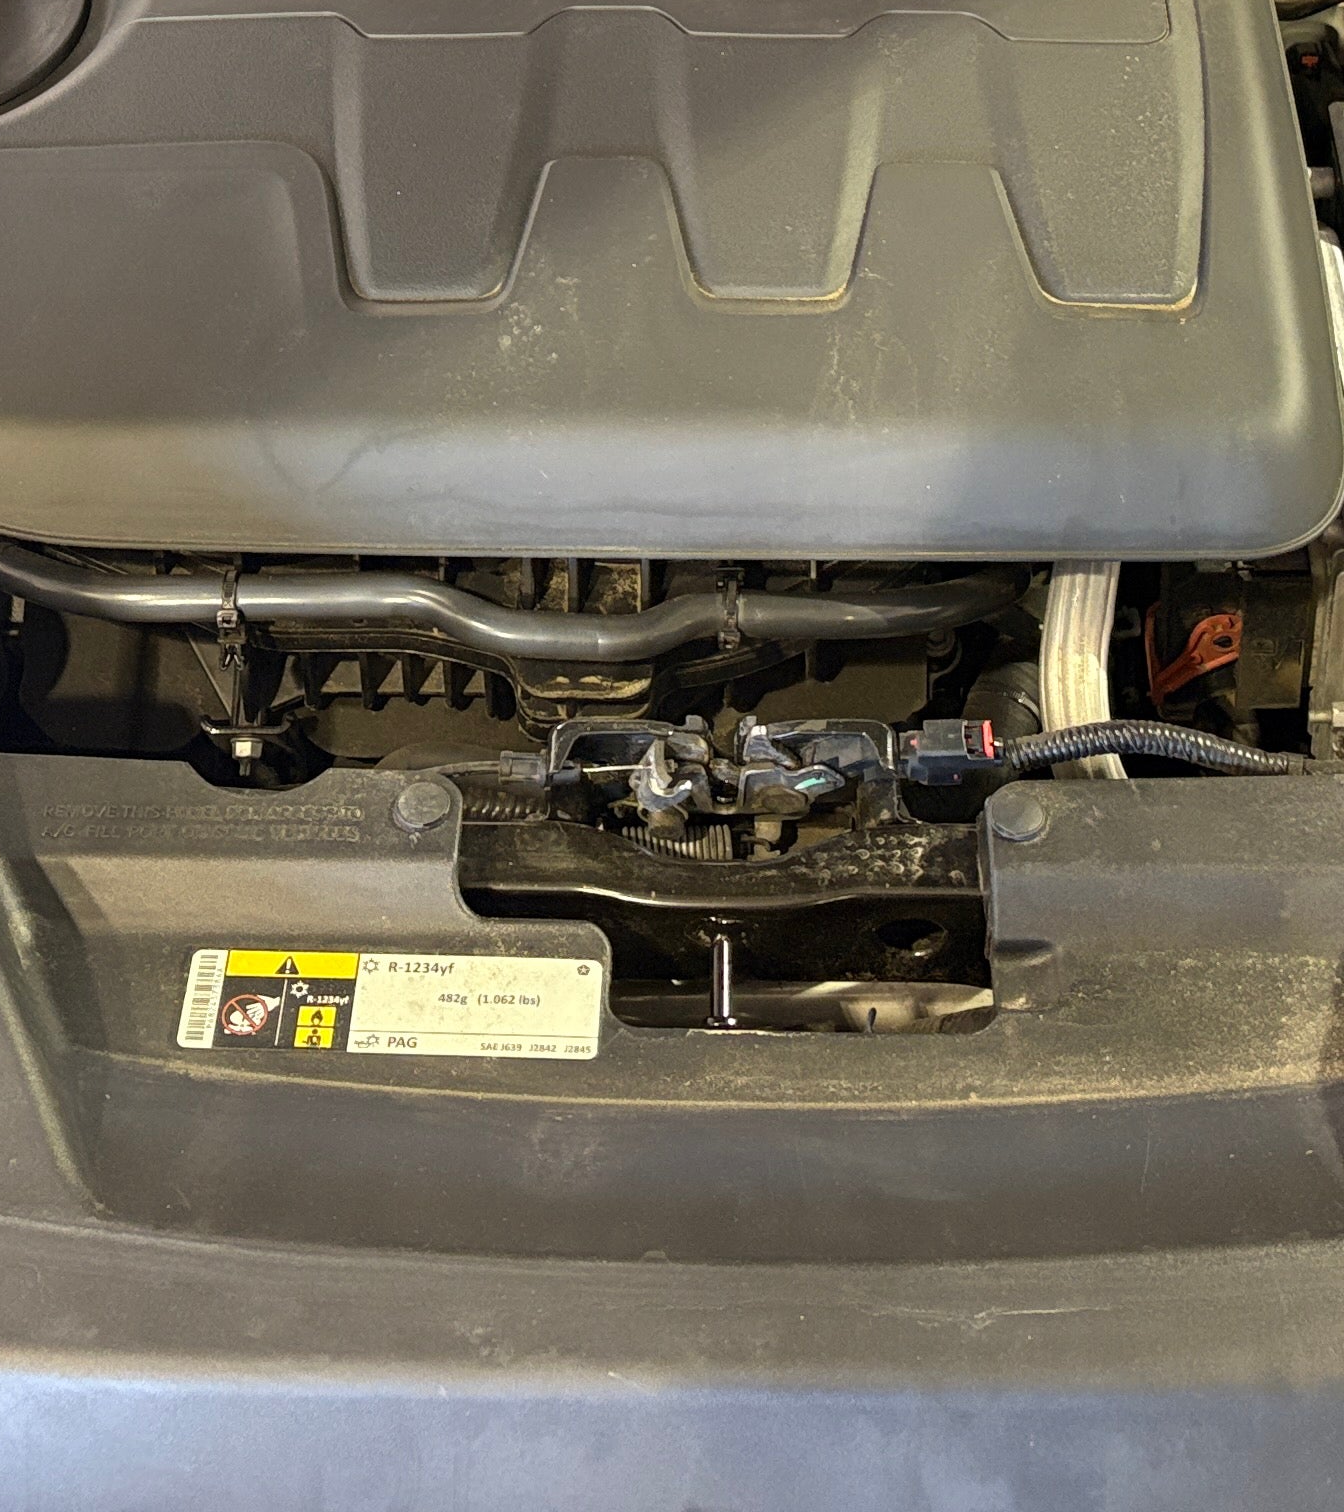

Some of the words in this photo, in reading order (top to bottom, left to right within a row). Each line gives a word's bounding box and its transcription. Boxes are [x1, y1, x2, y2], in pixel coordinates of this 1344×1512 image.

[388, 961, 455, 976] R-1234yf
[306, 995, 350, 1006] R-1234yf
[438, 993, 468, 1006] 482g
[477, 994, 516, 1006] (1.062
[518, 994, 541, 1007] lbs)
[387, 1037, 418, 1049] PAG
[480, 1042, 498, 1051] SAE
[500, 1043, 523, 1052] J639
[529, 1043, 557, 1053] J2842
[564, 1044, 592, 1054] J2845
